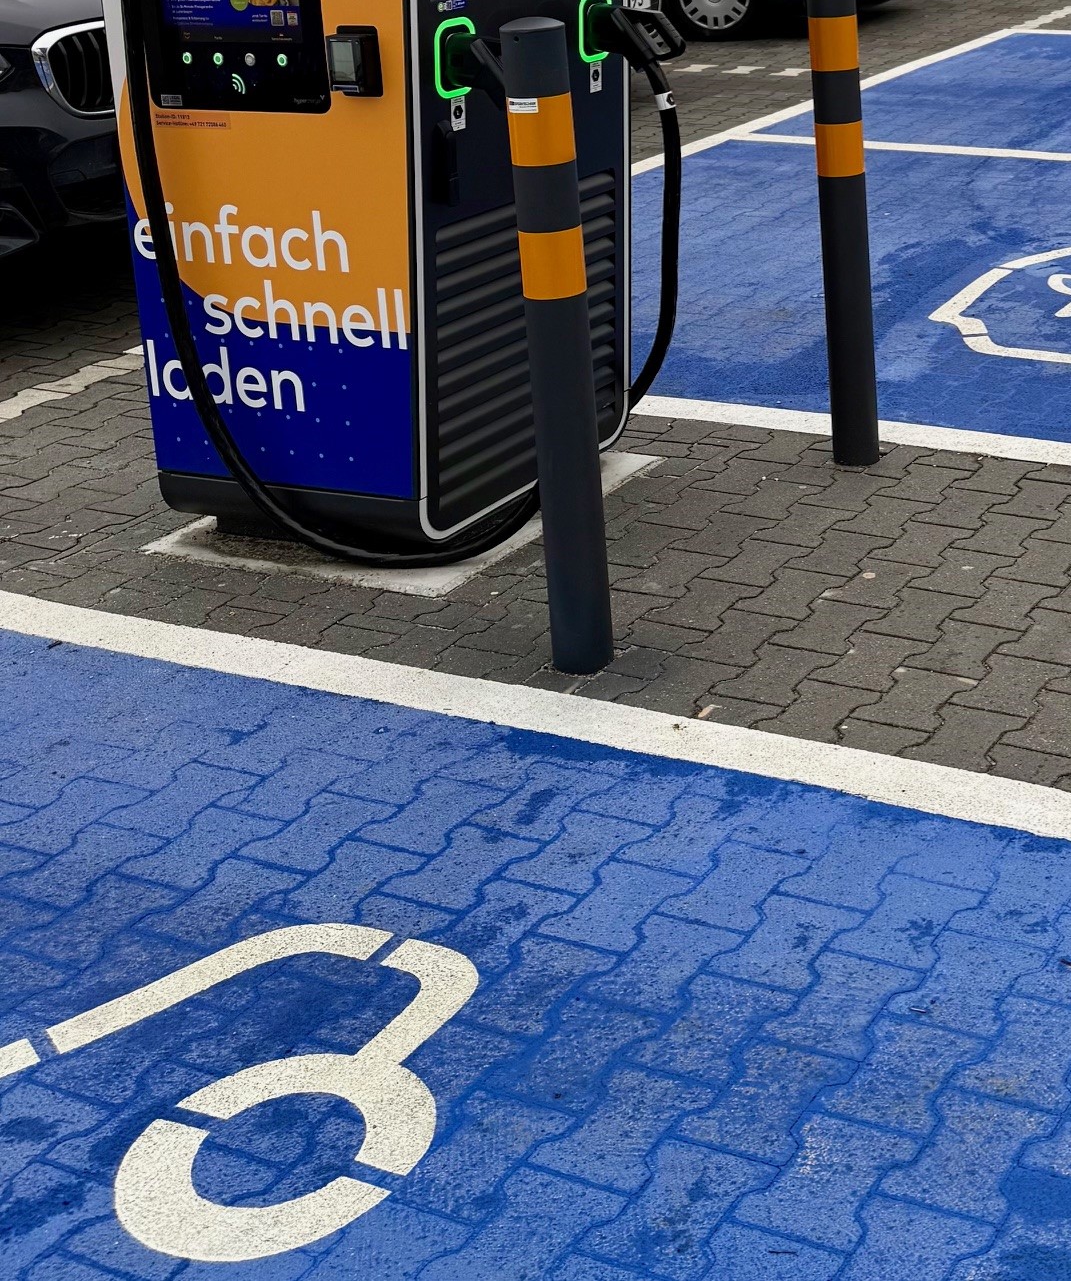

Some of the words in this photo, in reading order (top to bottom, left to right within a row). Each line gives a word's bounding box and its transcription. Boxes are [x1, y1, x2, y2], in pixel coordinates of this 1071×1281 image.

[134, 204, 350, 273] einfach
[203, 279, 408, 350] schnell
[146, 339, 306, 412] laden
